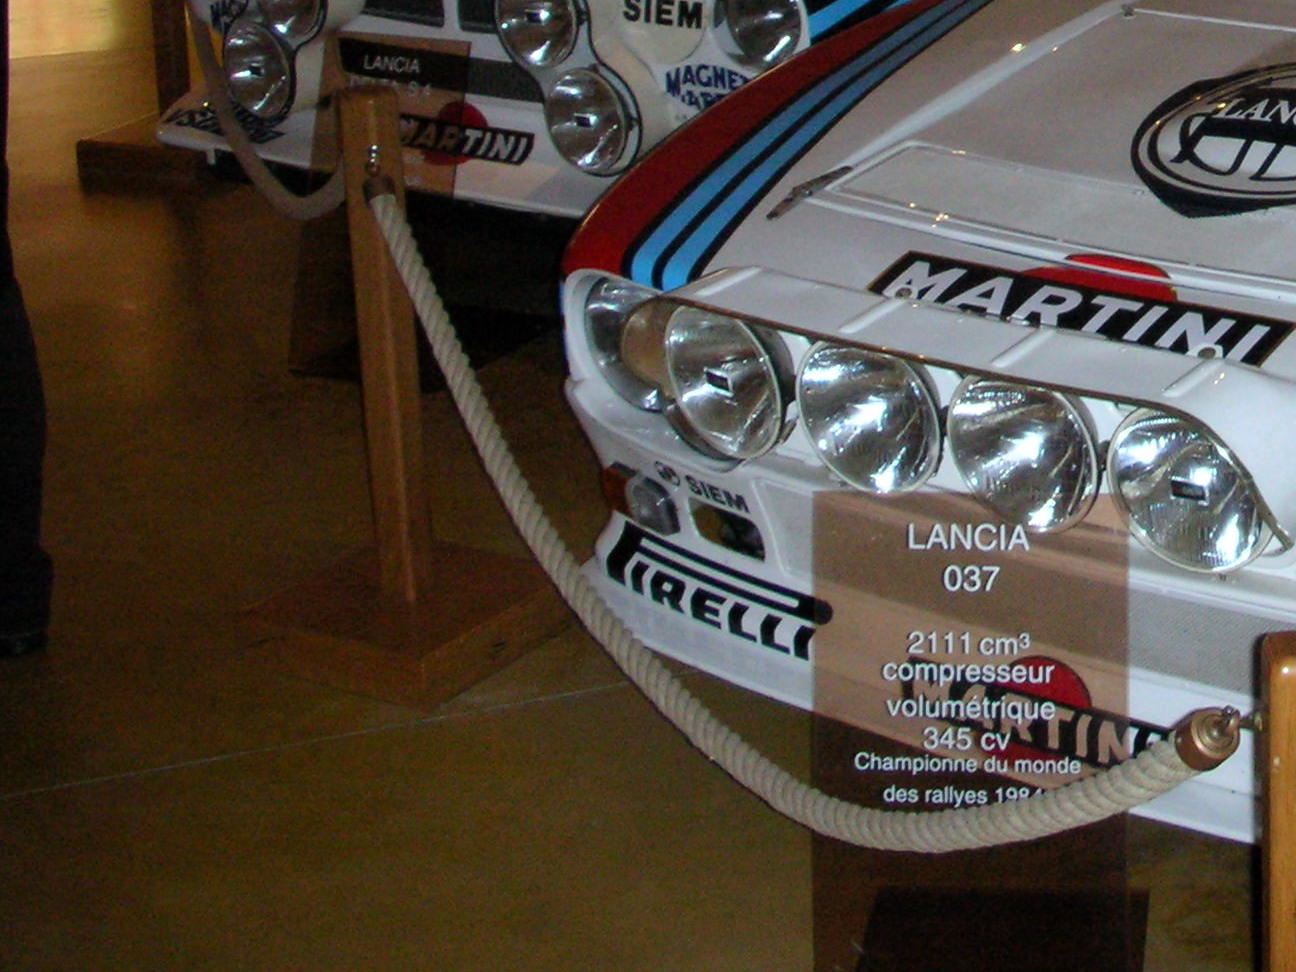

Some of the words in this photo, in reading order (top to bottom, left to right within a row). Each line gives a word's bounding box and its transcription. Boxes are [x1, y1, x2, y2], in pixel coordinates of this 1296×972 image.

[363, 54, 421, 73] LANCIA
[666, 64, 750, 97] MAGNE
[882, 260, 1271, 364] MARTINI
[685, 474, 751, 514] SIEM
[907, 524, 1030, 552] LANCIA
[606, 520, 834, 661] PIRELLI
[943, 565, 1000, 593] 037
[907, 631, 971, 655] 2111
[882, 661, 1055, 686] compresseur
[886, 695, 1056, 724] volumétrique
[922, 727, 972, 751] 345
[981, 731, 1011, 751] cv
[854, 752, 977, 775] Championne
[983, 755, 1009, 774] du
[1014, 756, 1082, 775] monde
[883, 784, 919, 803] des
[924, 785, 988, 807] rallyes
